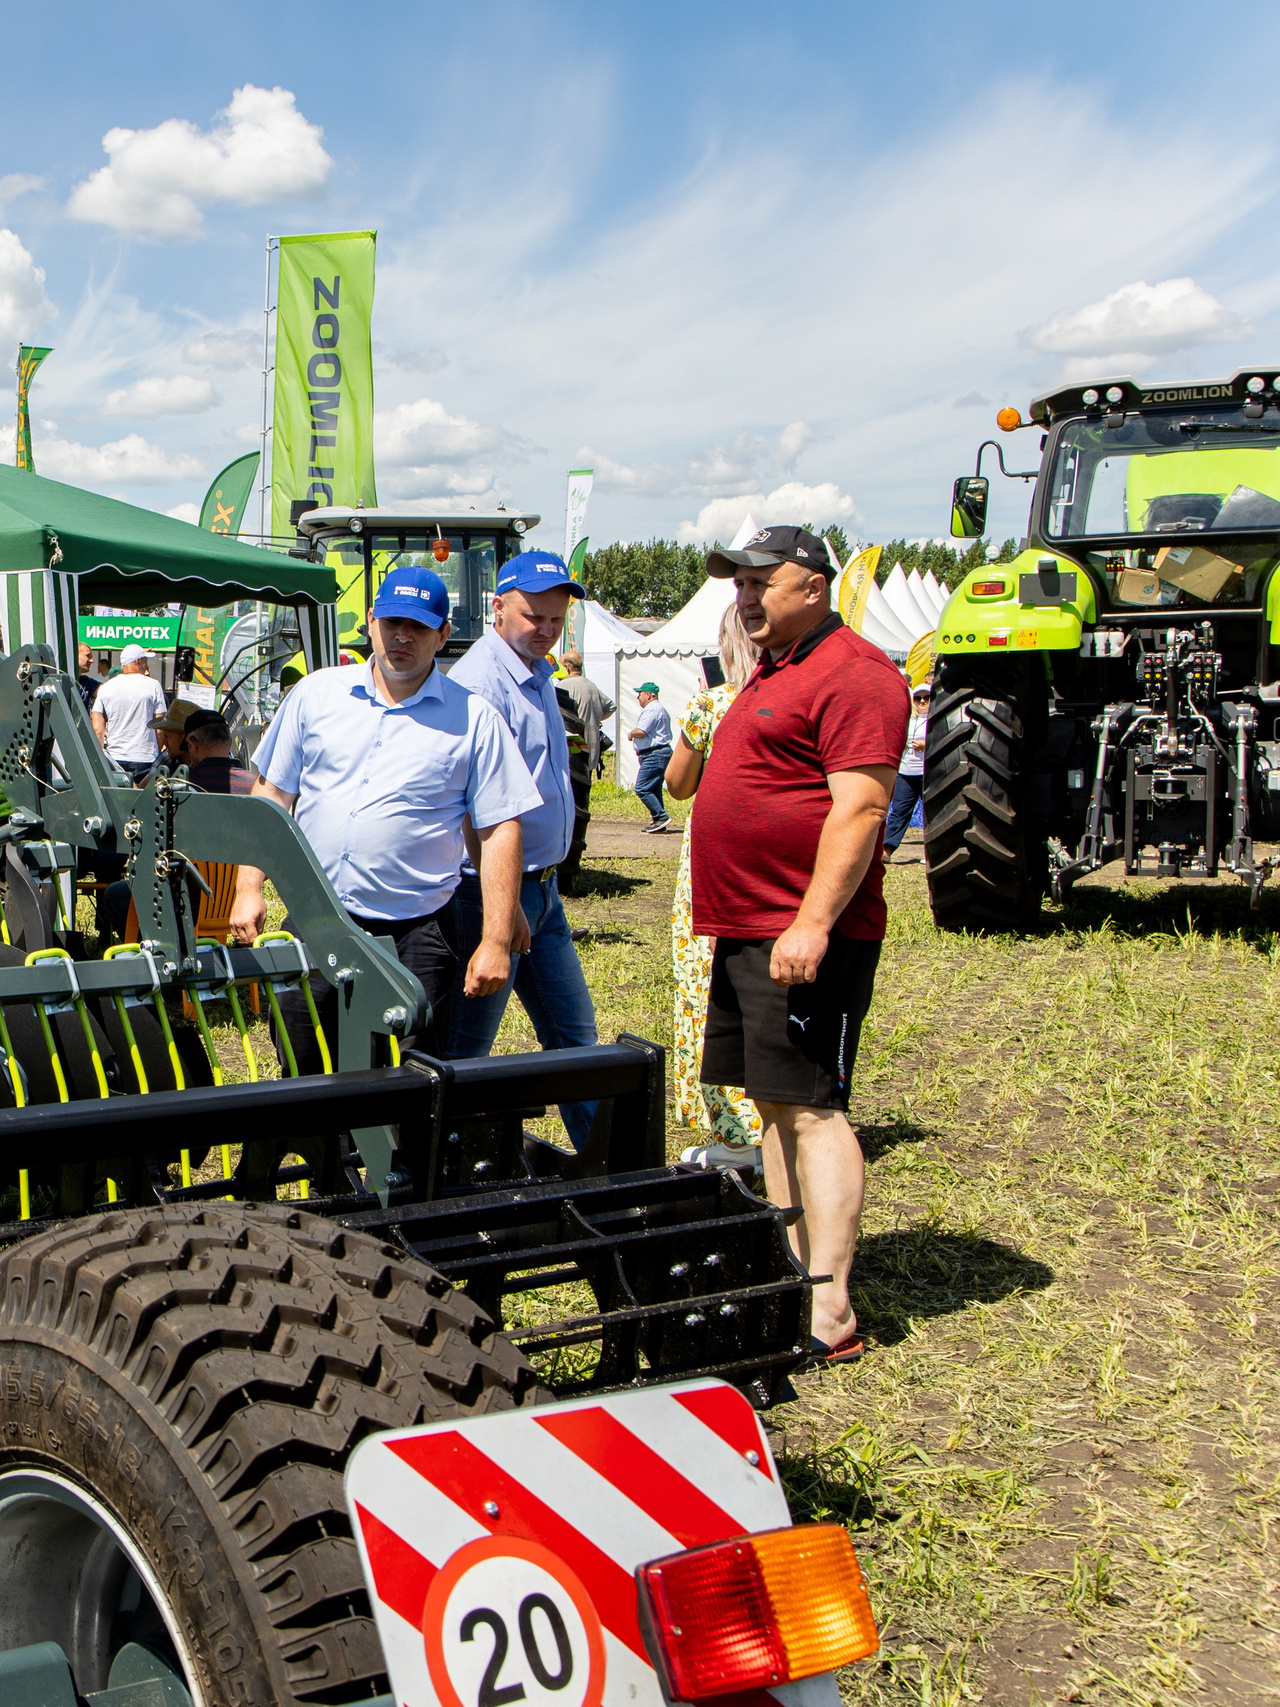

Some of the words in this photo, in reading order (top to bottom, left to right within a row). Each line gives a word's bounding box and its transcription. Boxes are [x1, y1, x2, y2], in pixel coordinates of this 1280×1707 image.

[307, 275, 341, 508] ZOOMLIO
[1141, 385, 1233, 404] ZOOMLION
[86, 625, 170, 640] ИНАГРОТЕХ
[838, 1013, 848, 1064] Motorsport
[460, 1592, 574, 1707] 20
